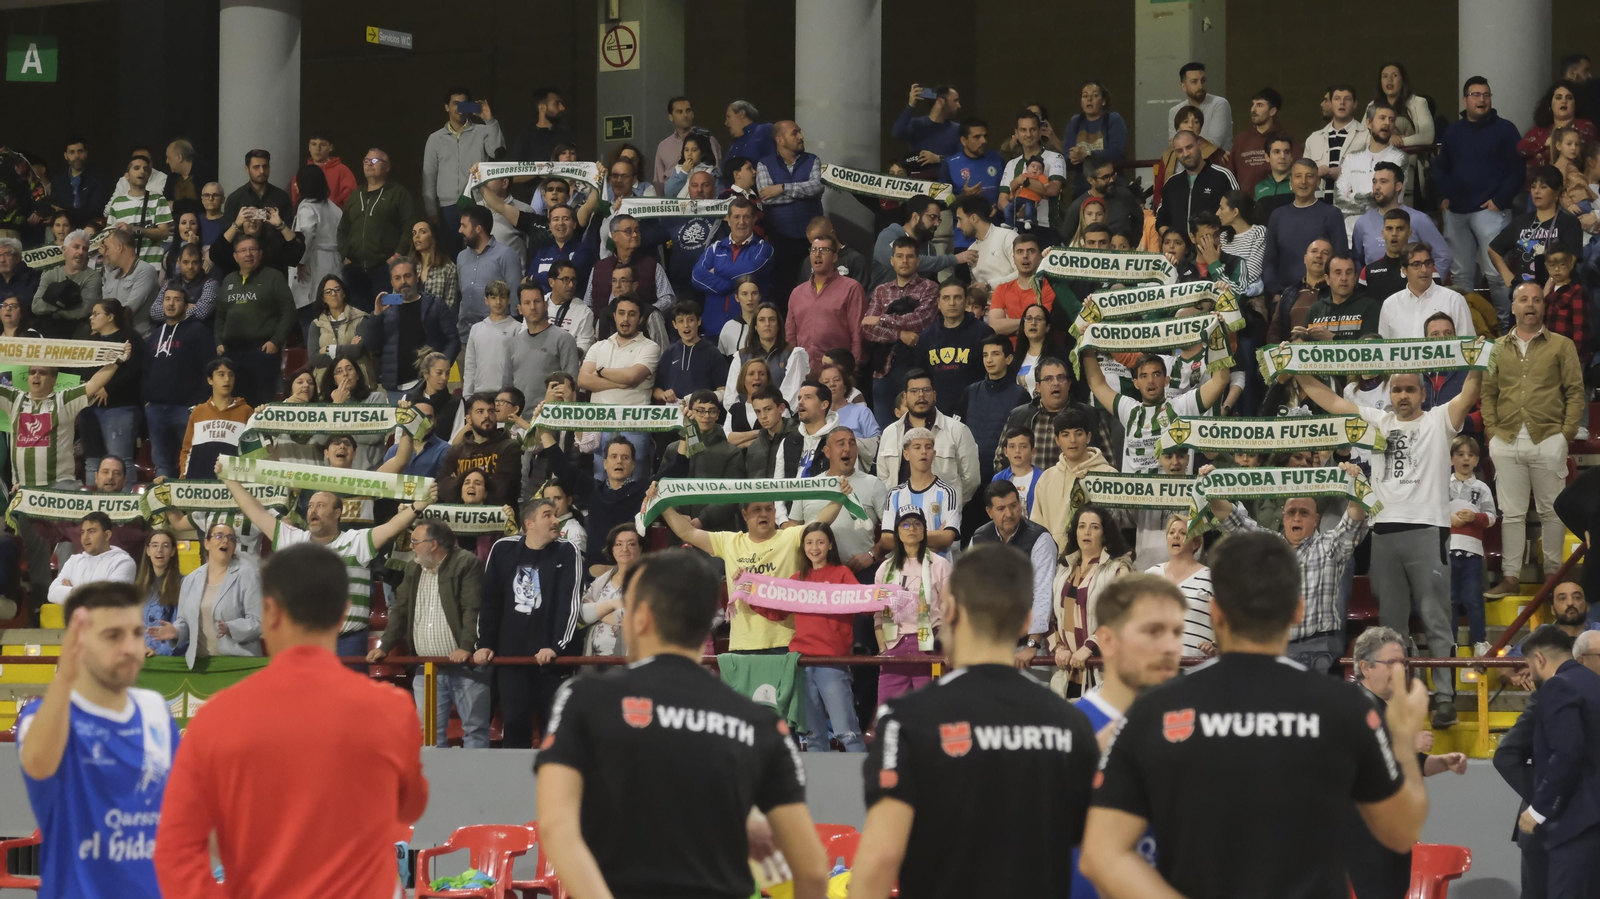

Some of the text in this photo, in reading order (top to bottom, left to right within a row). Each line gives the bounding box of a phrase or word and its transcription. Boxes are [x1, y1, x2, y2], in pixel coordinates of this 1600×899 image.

[379, 31, 400, 44] Servicios
[21, 43, 43, 74] A
[486, 166, 537, 177] CORDOBESISTA
[885, 178, 925, 194] FUTSAL
[627, 204, 680, 215] CORDOBESISTA
[22, 246, 63, 263] ÓRDOB
[1048, 252, 1173, 278] CÓRDOBA FUTSAL
[228, 291, 257, 302] ESPAÑA
[1098, 282, 1220, 309] CÓRDOBA FUTSAL
[1090, 325, 1161, 340] CÓRDOBA
[26, 345, 42, 359] DE
[44, 346, 95, 361] PRIMERA
[1298, 344, 1455, 362] CÓRDOBA FUTSAL
[1411, 359, 1457, 368] HUMANIDAD
[254, 408, 388, 423] CÓRDOBA FUTSAL
[540, 405, 679, 420] CÓRDOBA FUTSAL
[203, 421, 237, 434] AWESOME
[209, 430, 227, 438] TEAM
[1198, 422, 1338, 439] CÓRDOBA FUTSAL
[261, 468, 279, 477] LOS
[320, 475, 338, 484] DEL
[339, 477, 388, 490] FUTSAL
[667, 477, 838, 493] UNA VIDA. UN SENTIMIENTO
[1281, 469, 1349, 485] FUTSAL
[247, 485, 288, 499] UTSAL
[1085, 478, 1193, 497] CÓRDOBA FUTS
[28, 494, 139, 511] CÓRDOBA FUTSA
[455, 511, 505, 523] FUTSAL
[757, 581, 873, 605] CÓRDOBA GIRLS
[656, 704, 755, 746] WÜRTH
[1200, 712, 1320, 738] WÜRTH
[974, 725, 1073, 753] WÜRTH
